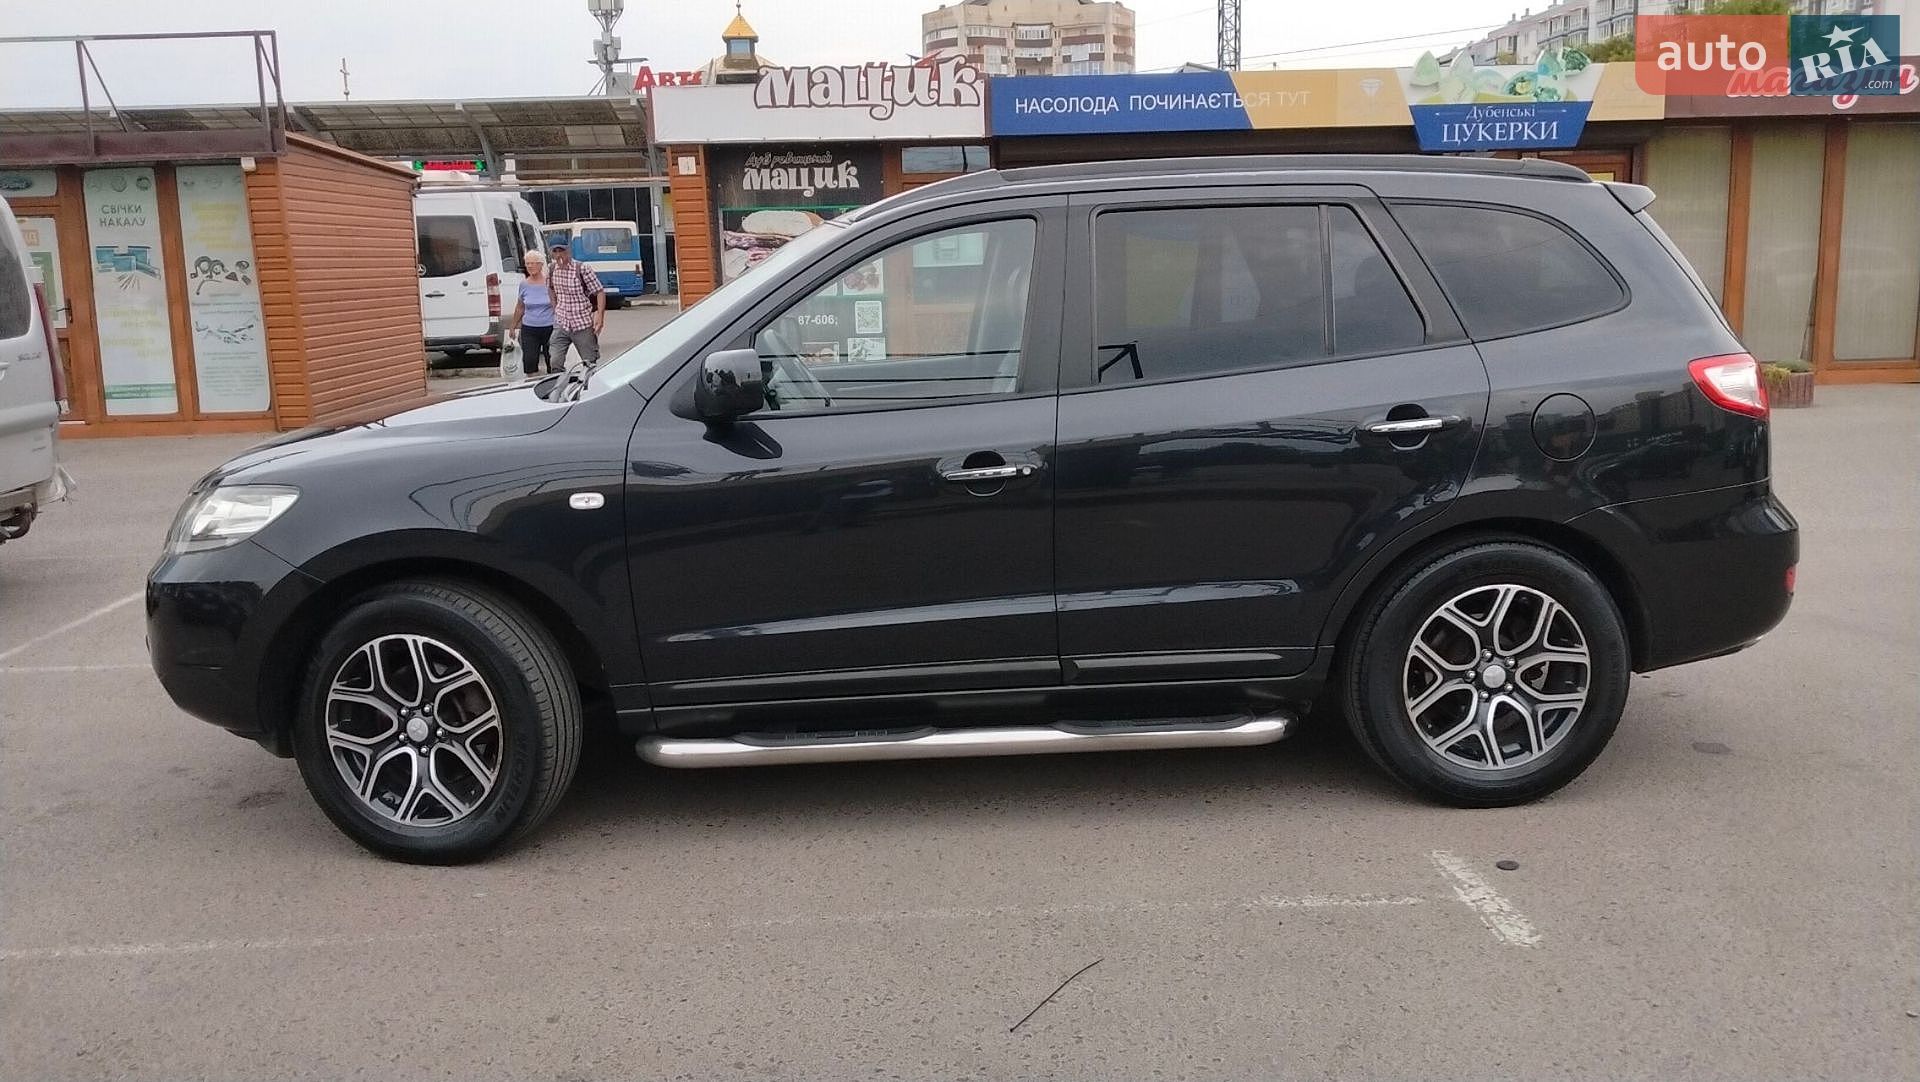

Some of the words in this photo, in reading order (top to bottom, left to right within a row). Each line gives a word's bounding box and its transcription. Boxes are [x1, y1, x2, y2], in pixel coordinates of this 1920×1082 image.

[1015, 96, 1120, 115] НАСОЛОДА
[1129, 91, 1271, 112] ПОЧИНАЄТЬСЯ
[1278, 90, 1311, 107] ТУТ
[1465, 105, 1536, 122] Дубенські
[1442, 121, 1559, 145] ЦУКЕРКИ
[101, 204, 143, 214] СВІЧКИ
[99, 217, 146, 227] НАКАЛУ
